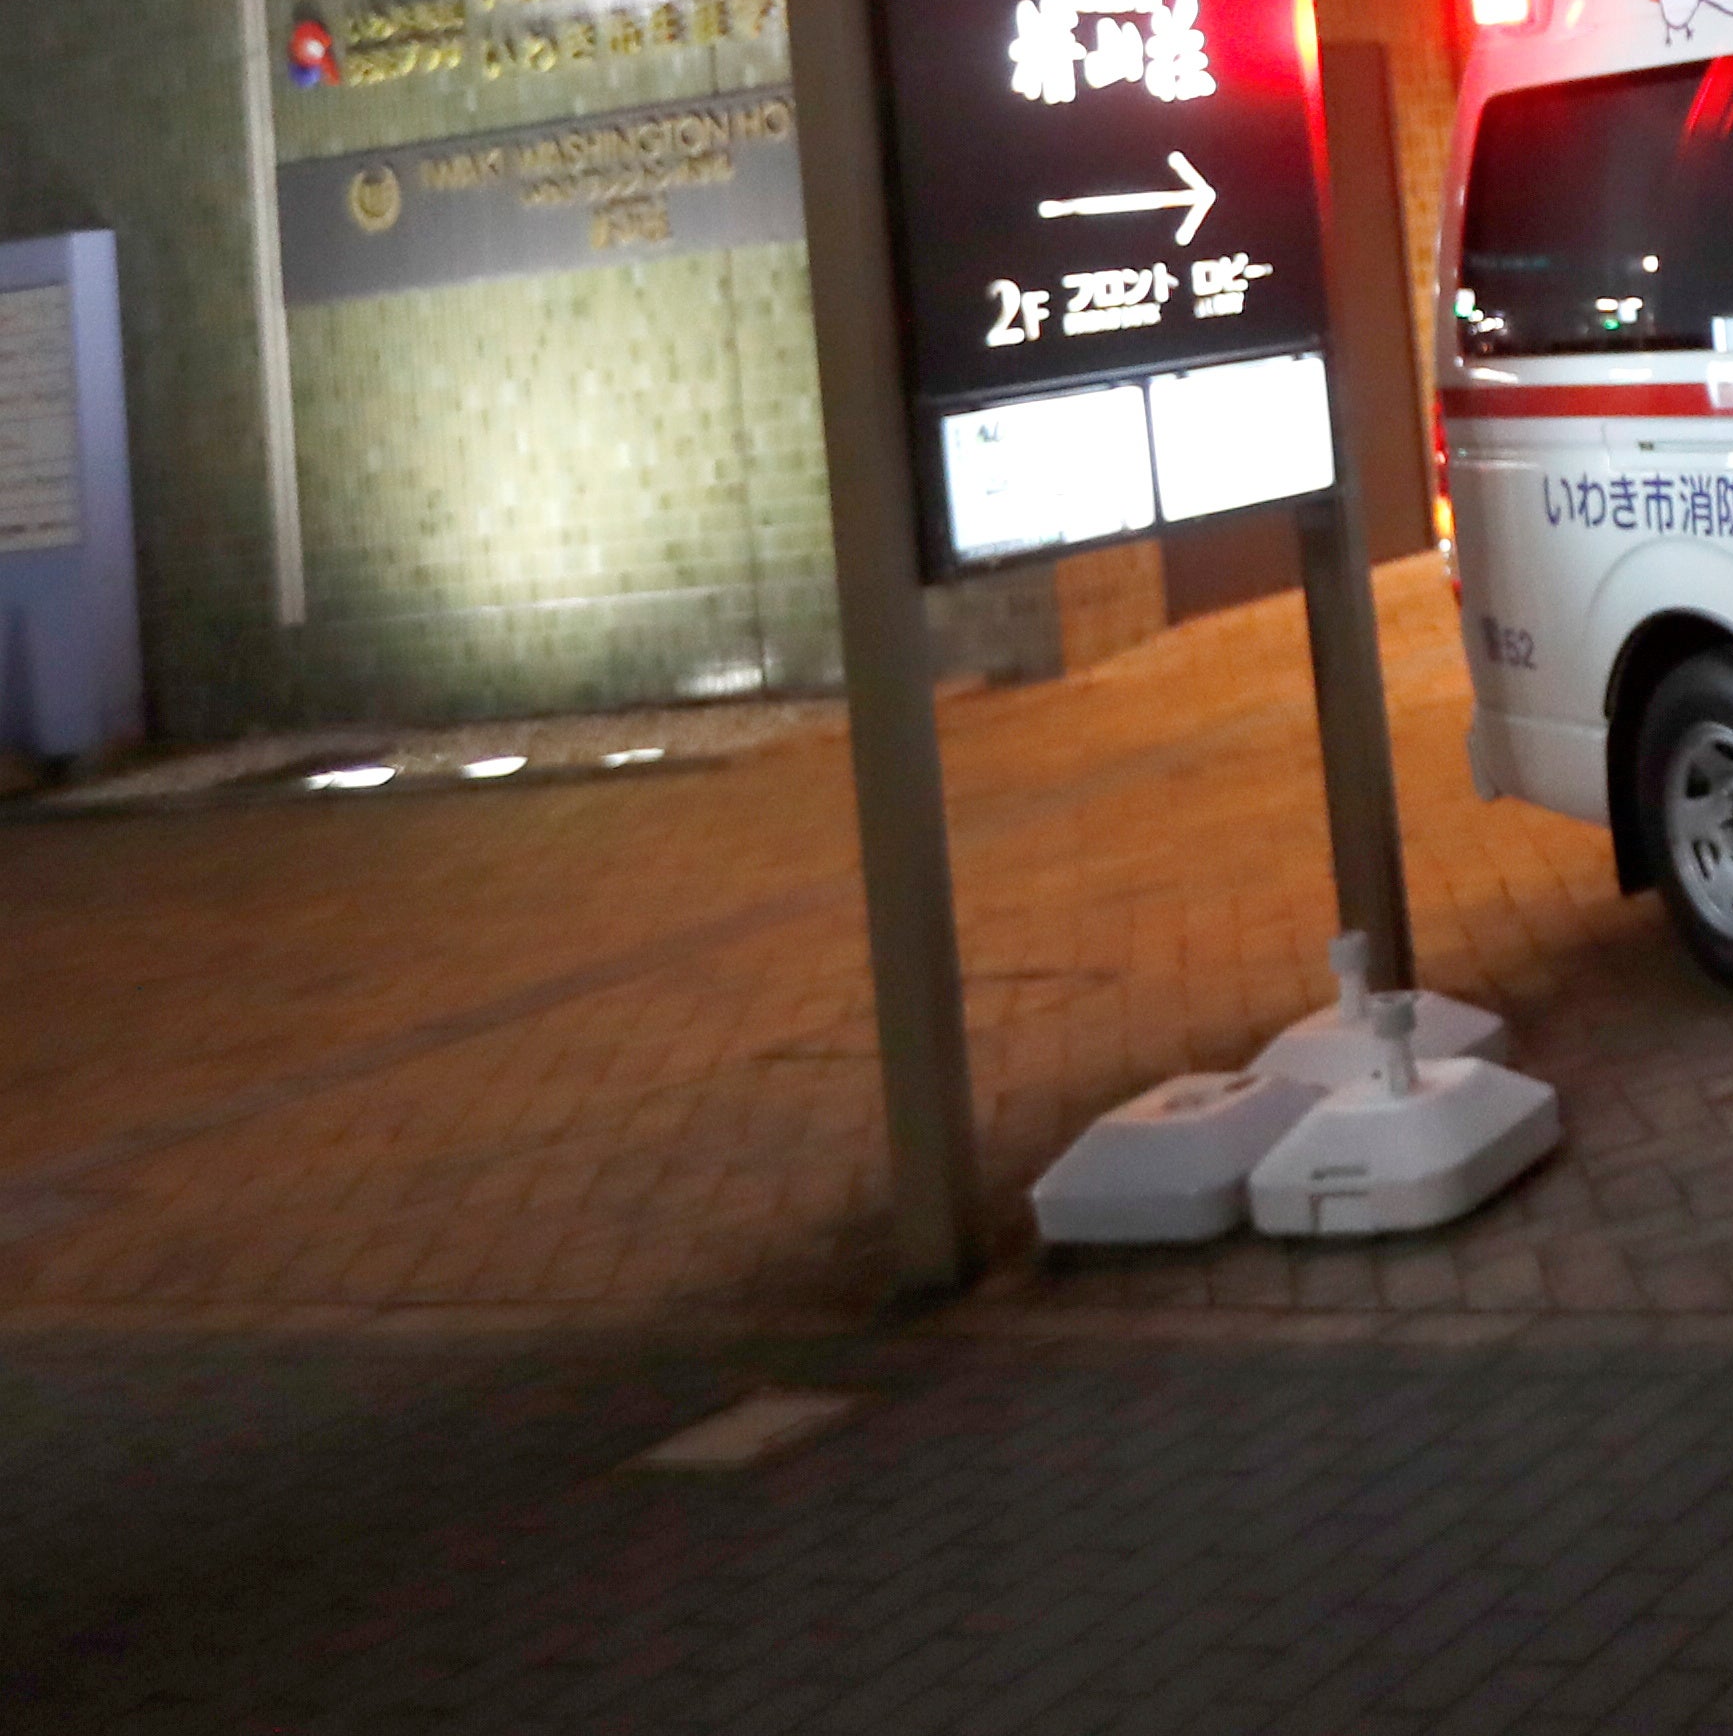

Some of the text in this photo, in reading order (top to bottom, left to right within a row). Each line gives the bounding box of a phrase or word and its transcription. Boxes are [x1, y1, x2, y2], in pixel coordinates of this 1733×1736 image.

[985, 278, 1051, 348] 2F
[1060, 262, 1181, 312] フロント
[1190, 252, 1275, 296] ロビー
